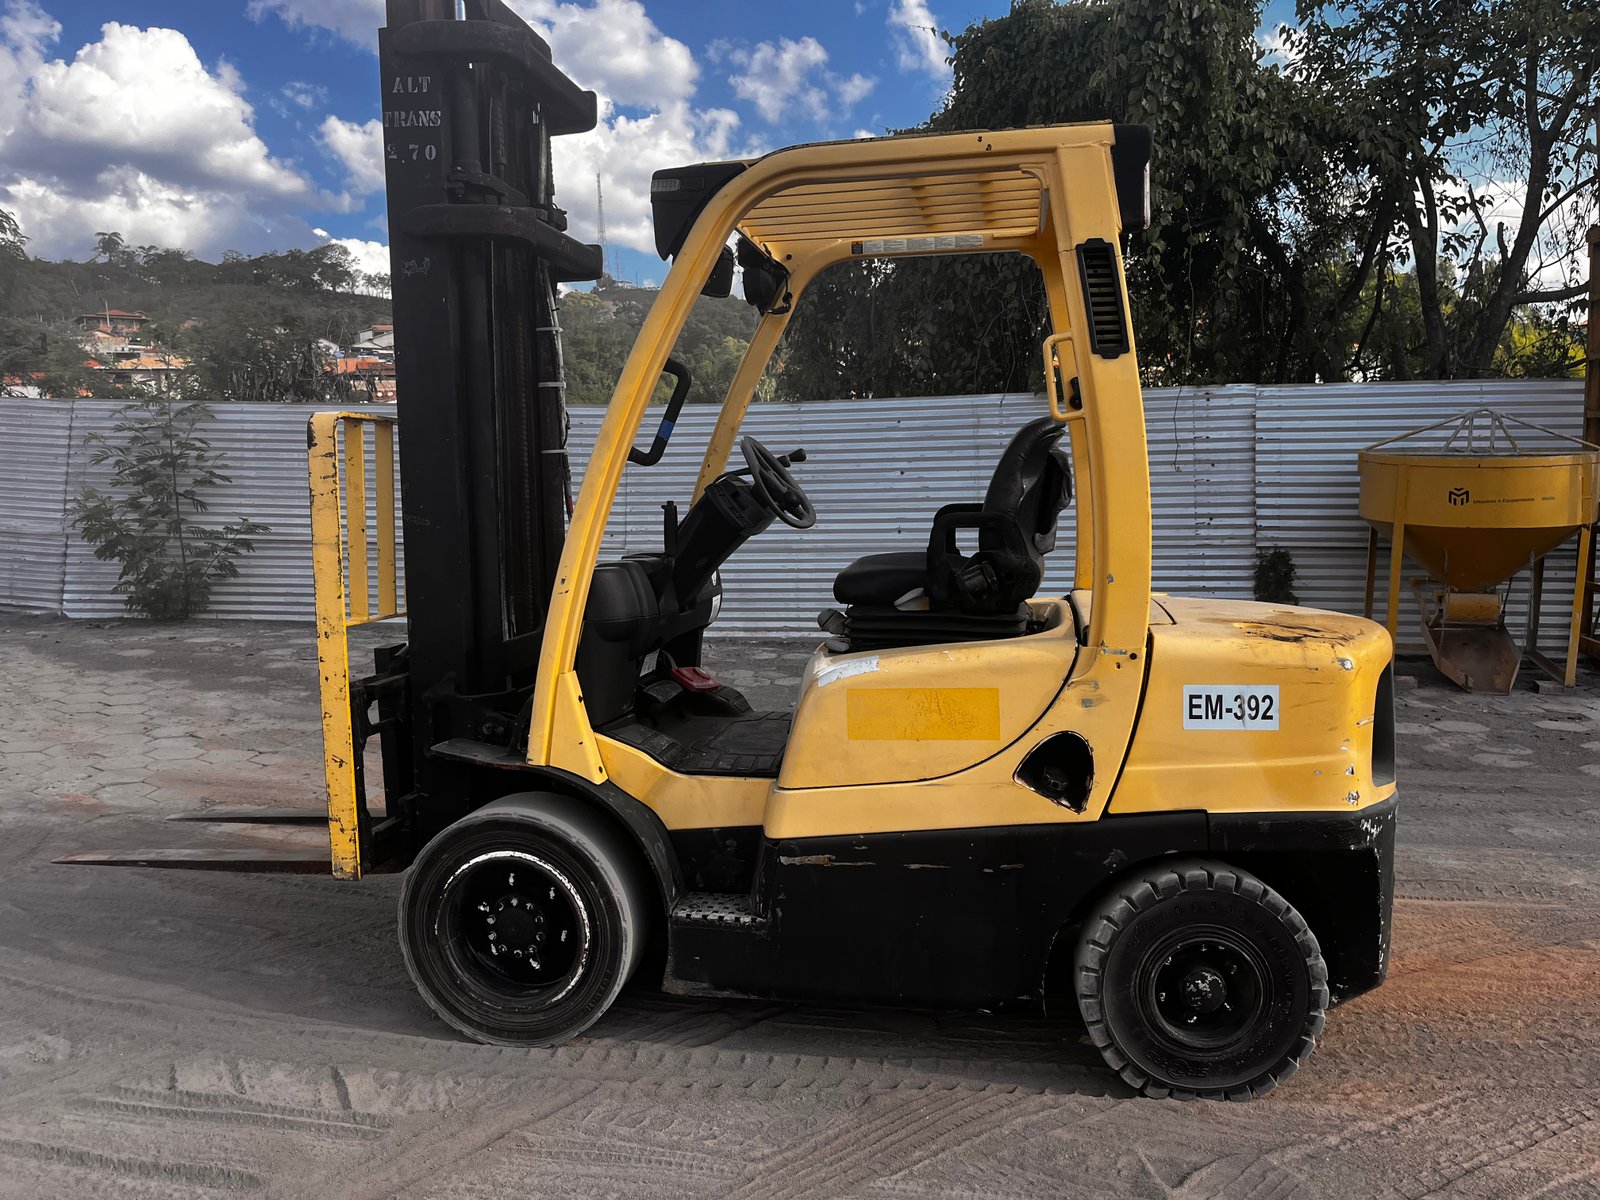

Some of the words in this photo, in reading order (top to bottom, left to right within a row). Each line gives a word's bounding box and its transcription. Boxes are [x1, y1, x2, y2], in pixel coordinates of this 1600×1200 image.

[392, 76, 431, 93] ALT
[384, 110, 441, 128] TRANS
[1188, 694, 1274, 721] EM-392
